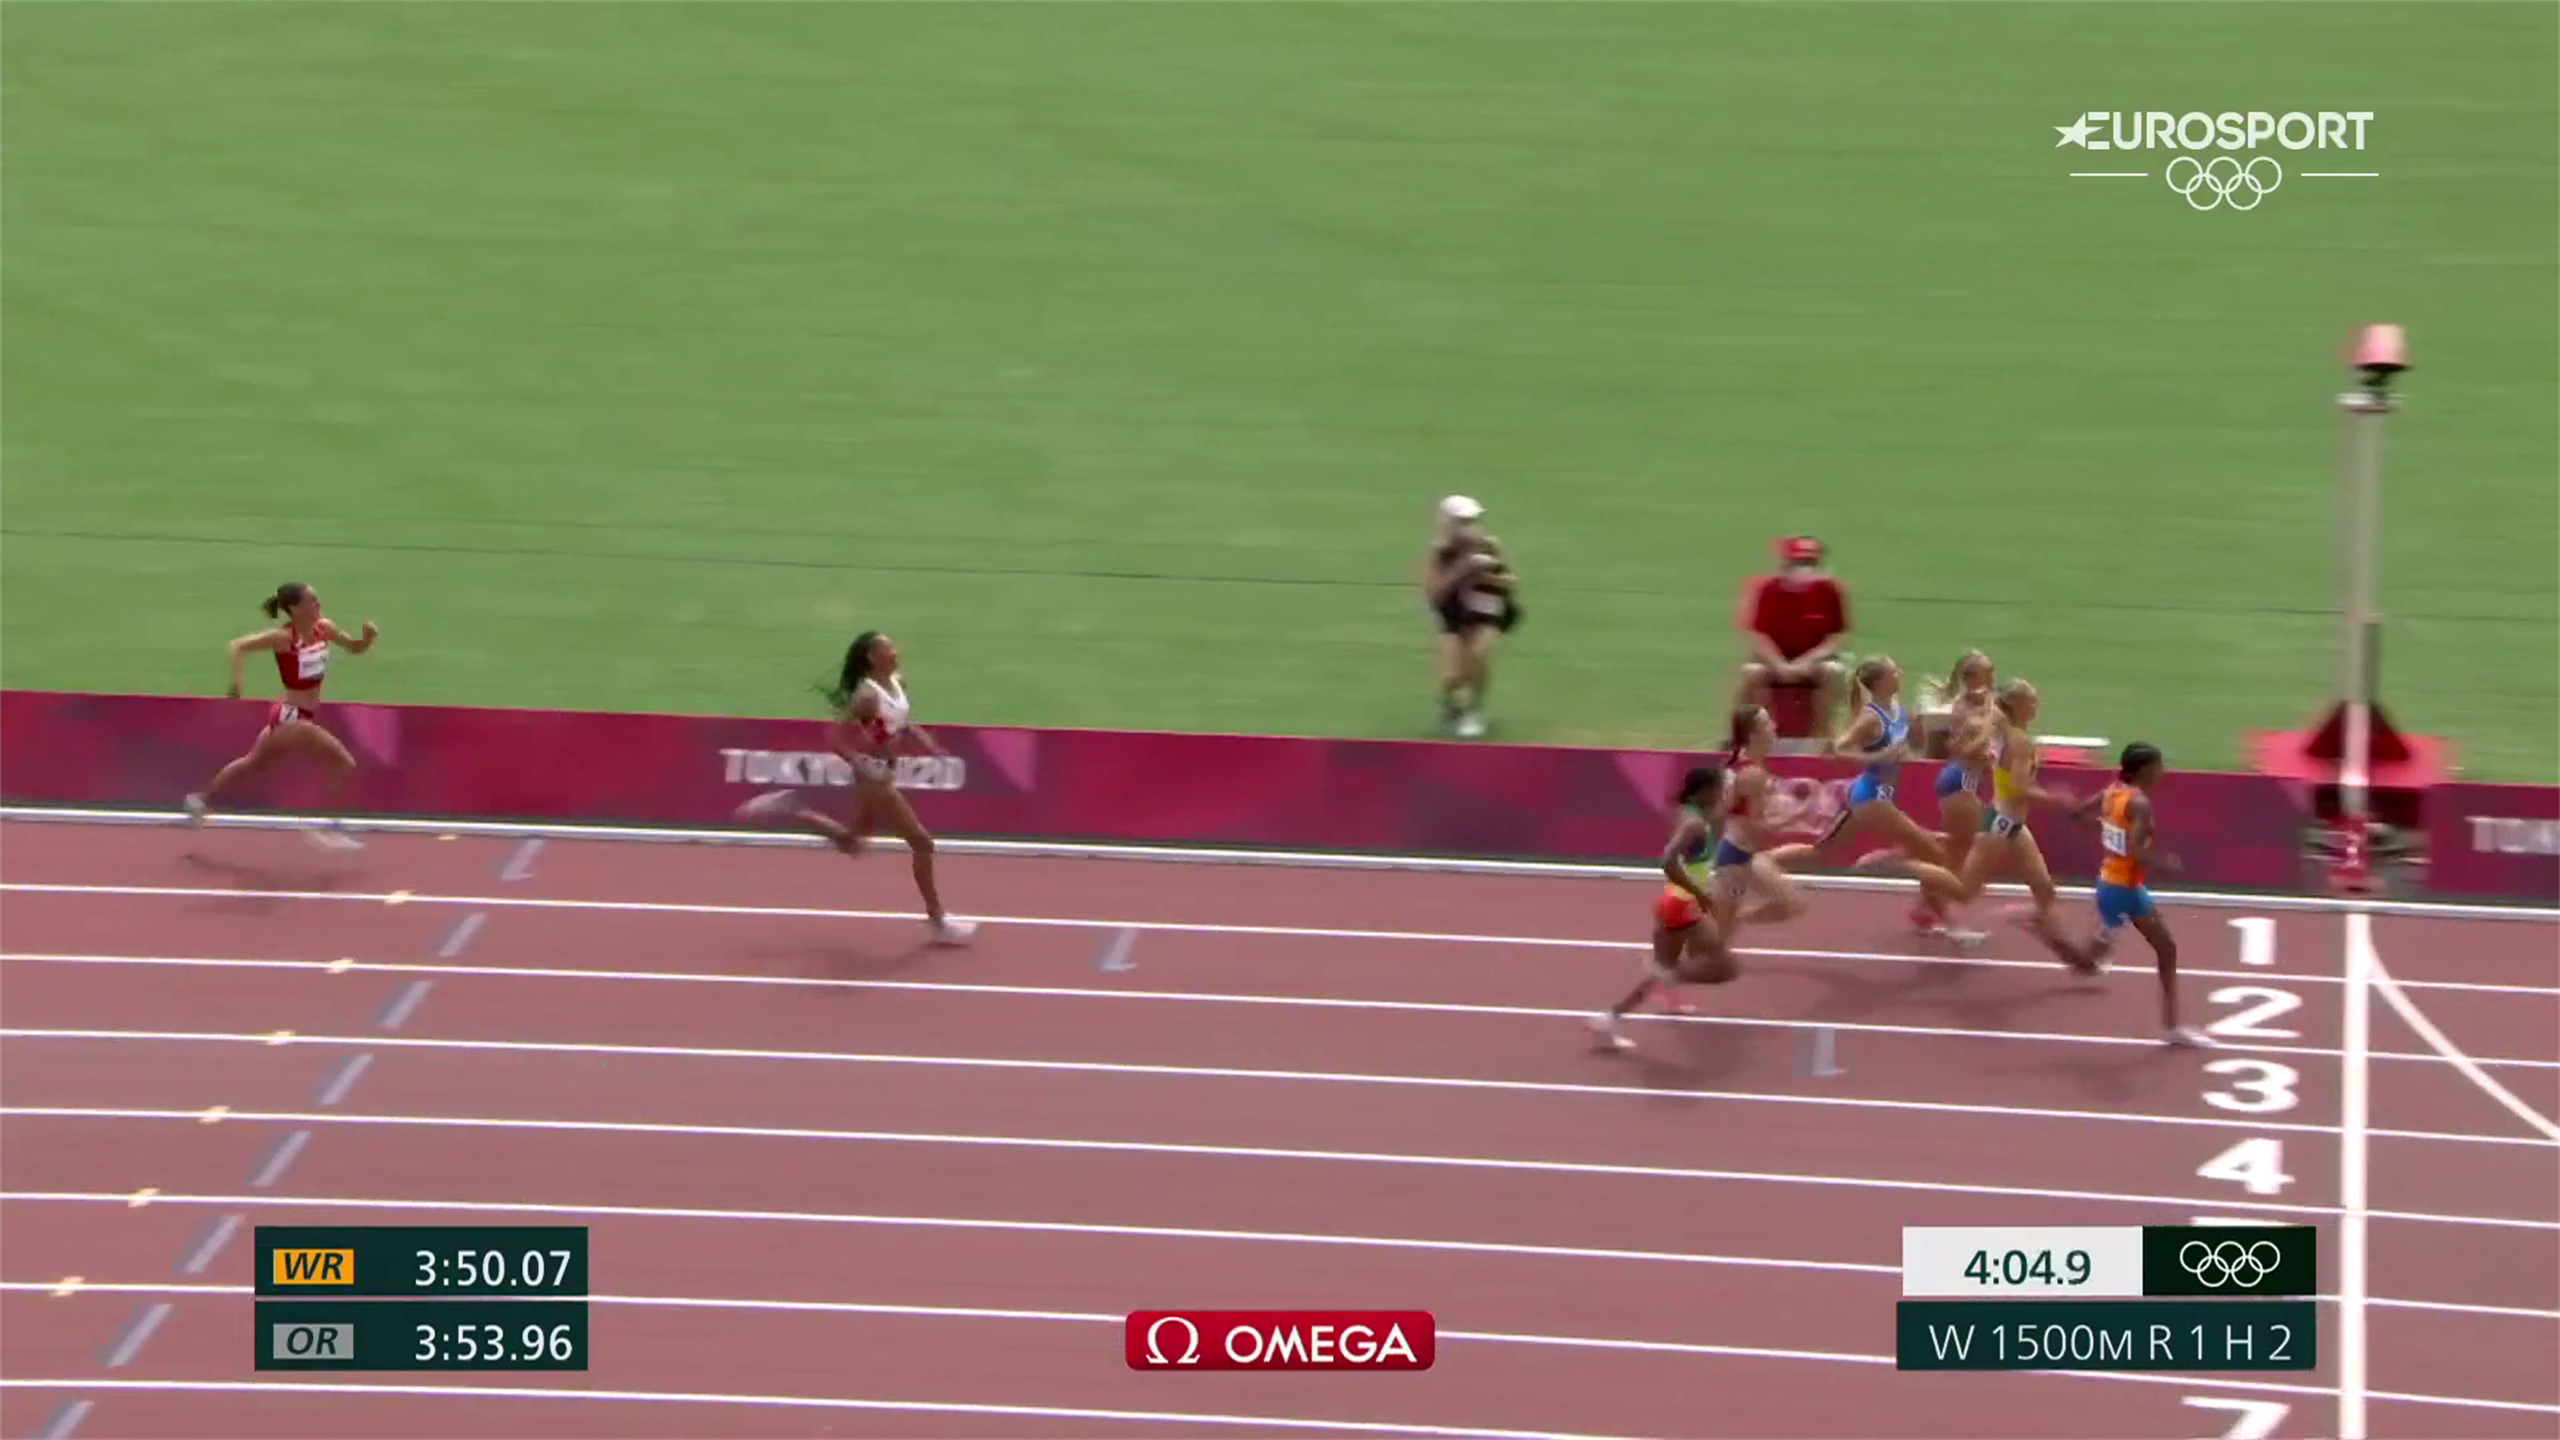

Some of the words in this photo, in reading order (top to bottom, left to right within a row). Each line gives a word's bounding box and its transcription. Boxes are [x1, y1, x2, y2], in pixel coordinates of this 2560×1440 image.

[2227, 917, 2277, 965] 1
[2205, 986, 2303, 1038] 2
[2202, 1059, 2299, 1113] 3
[2196, 1138, 2296, 1195] 4
[2181, 1395, 2292, 1440] 7
